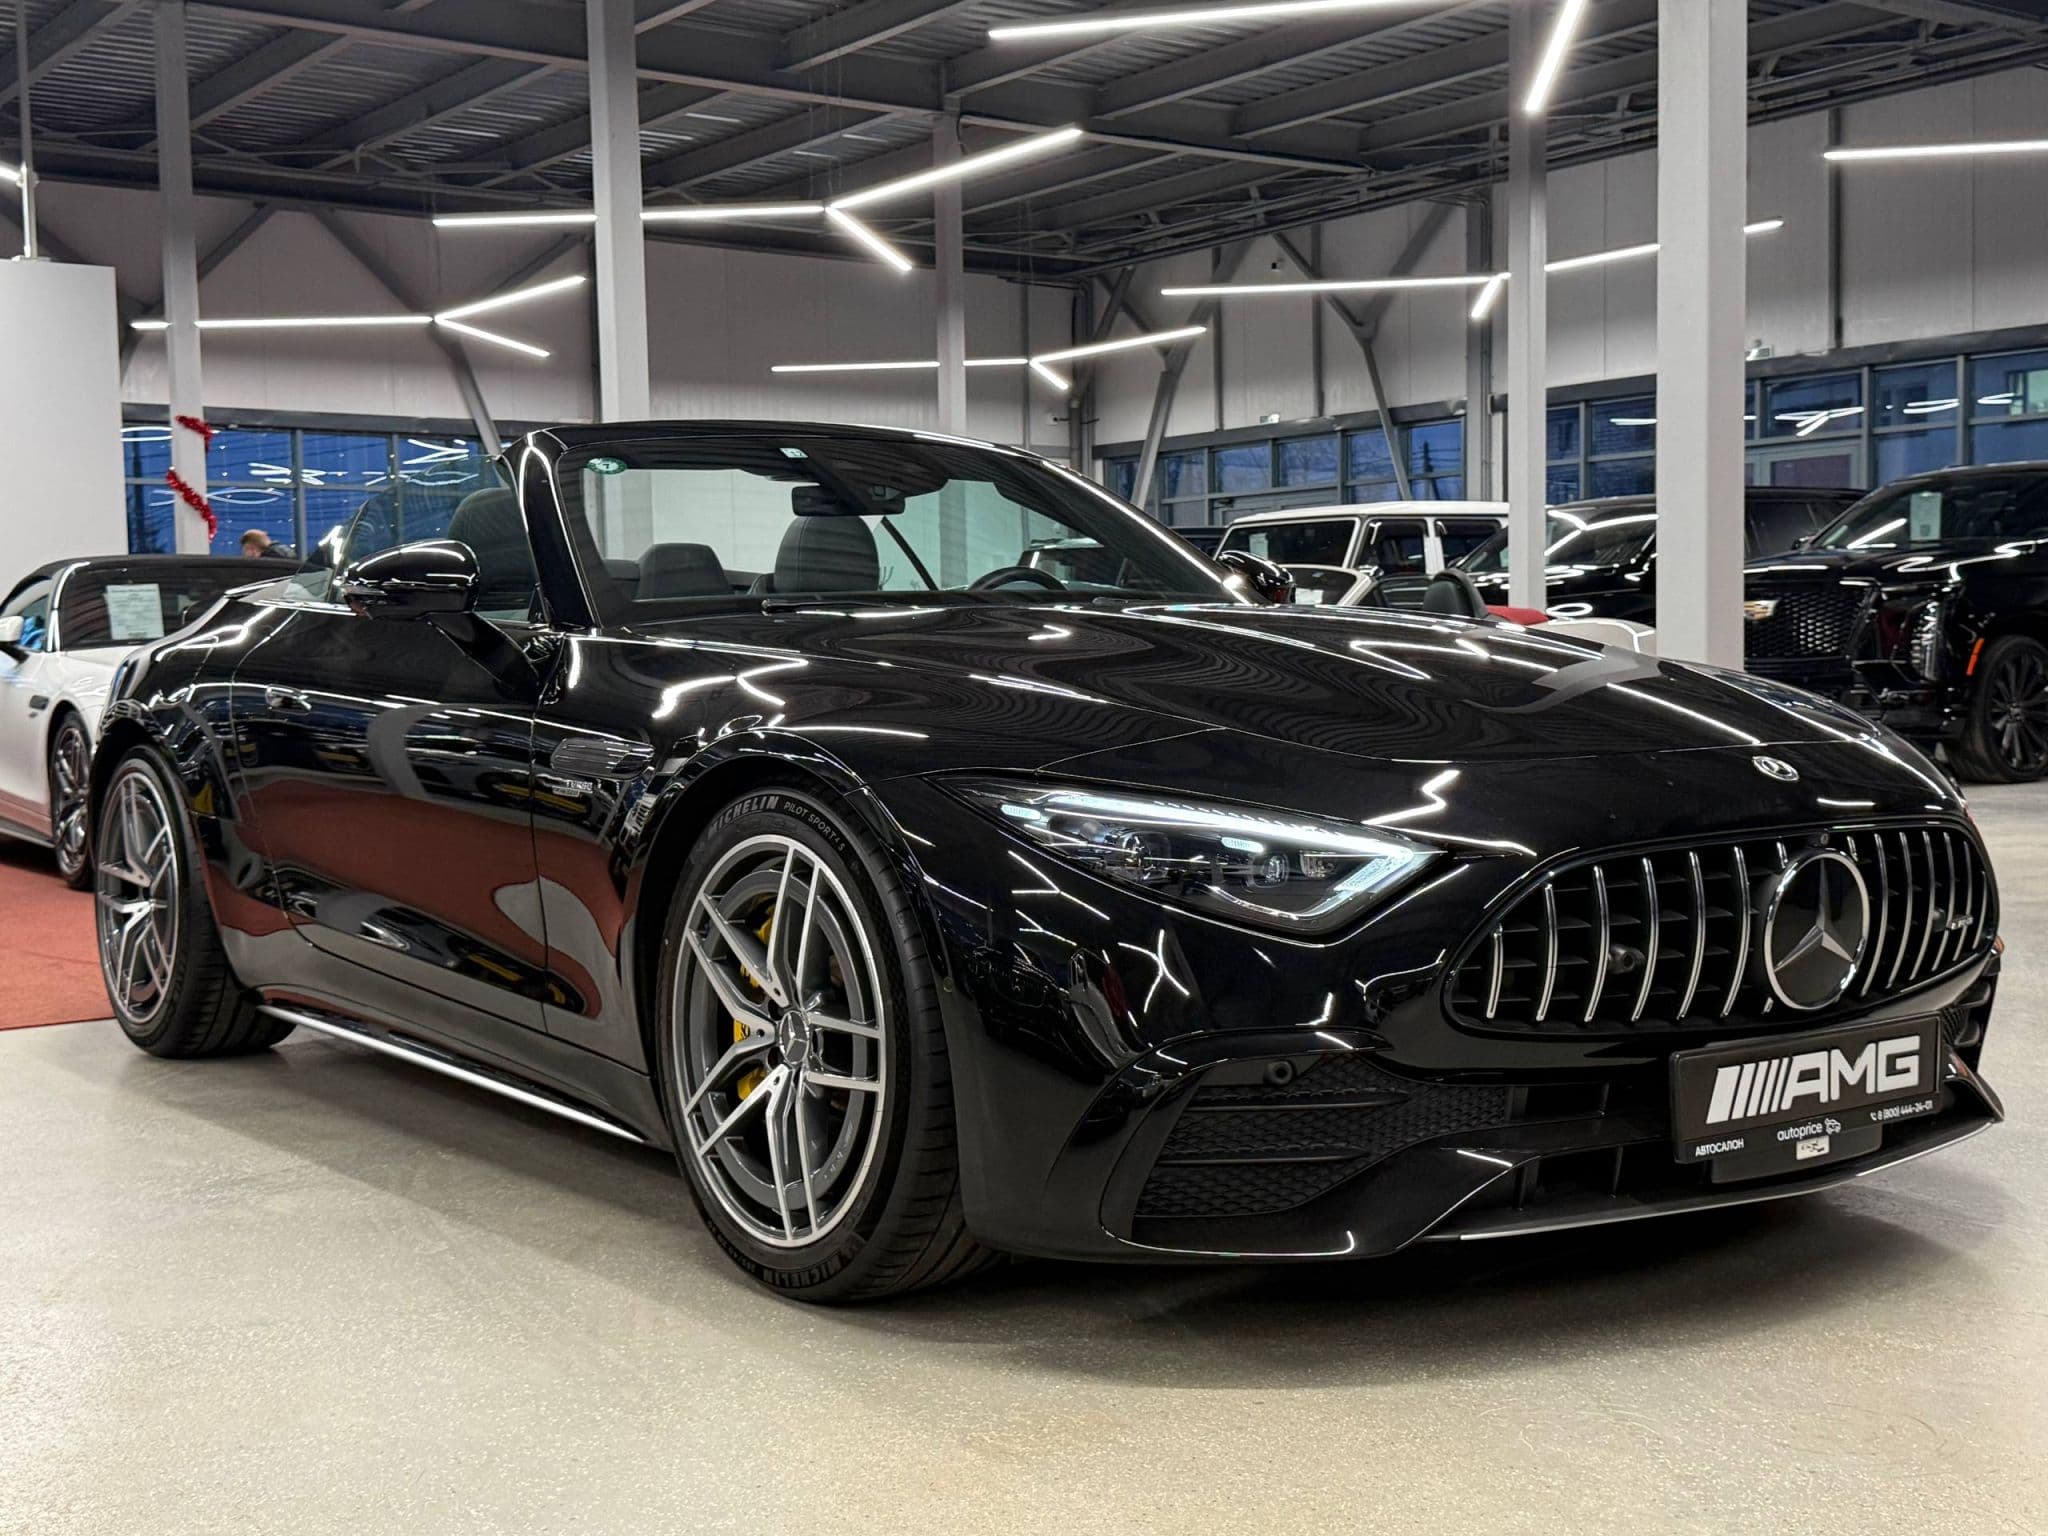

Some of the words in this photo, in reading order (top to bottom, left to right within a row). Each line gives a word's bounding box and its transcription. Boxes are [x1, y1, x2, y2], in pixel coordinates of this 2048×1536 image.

[708, 795, 780, 840] MICHELIN
[783, 801, 808, 818] PILOT
[808, 813, 835, 840] SPORT
[1780, 1035, 1920, 1110] AMG
[1777, 1121, 1823, 1141] autoprice
[1695, 1138, 1745, 1157] АВТОСАЛОН
